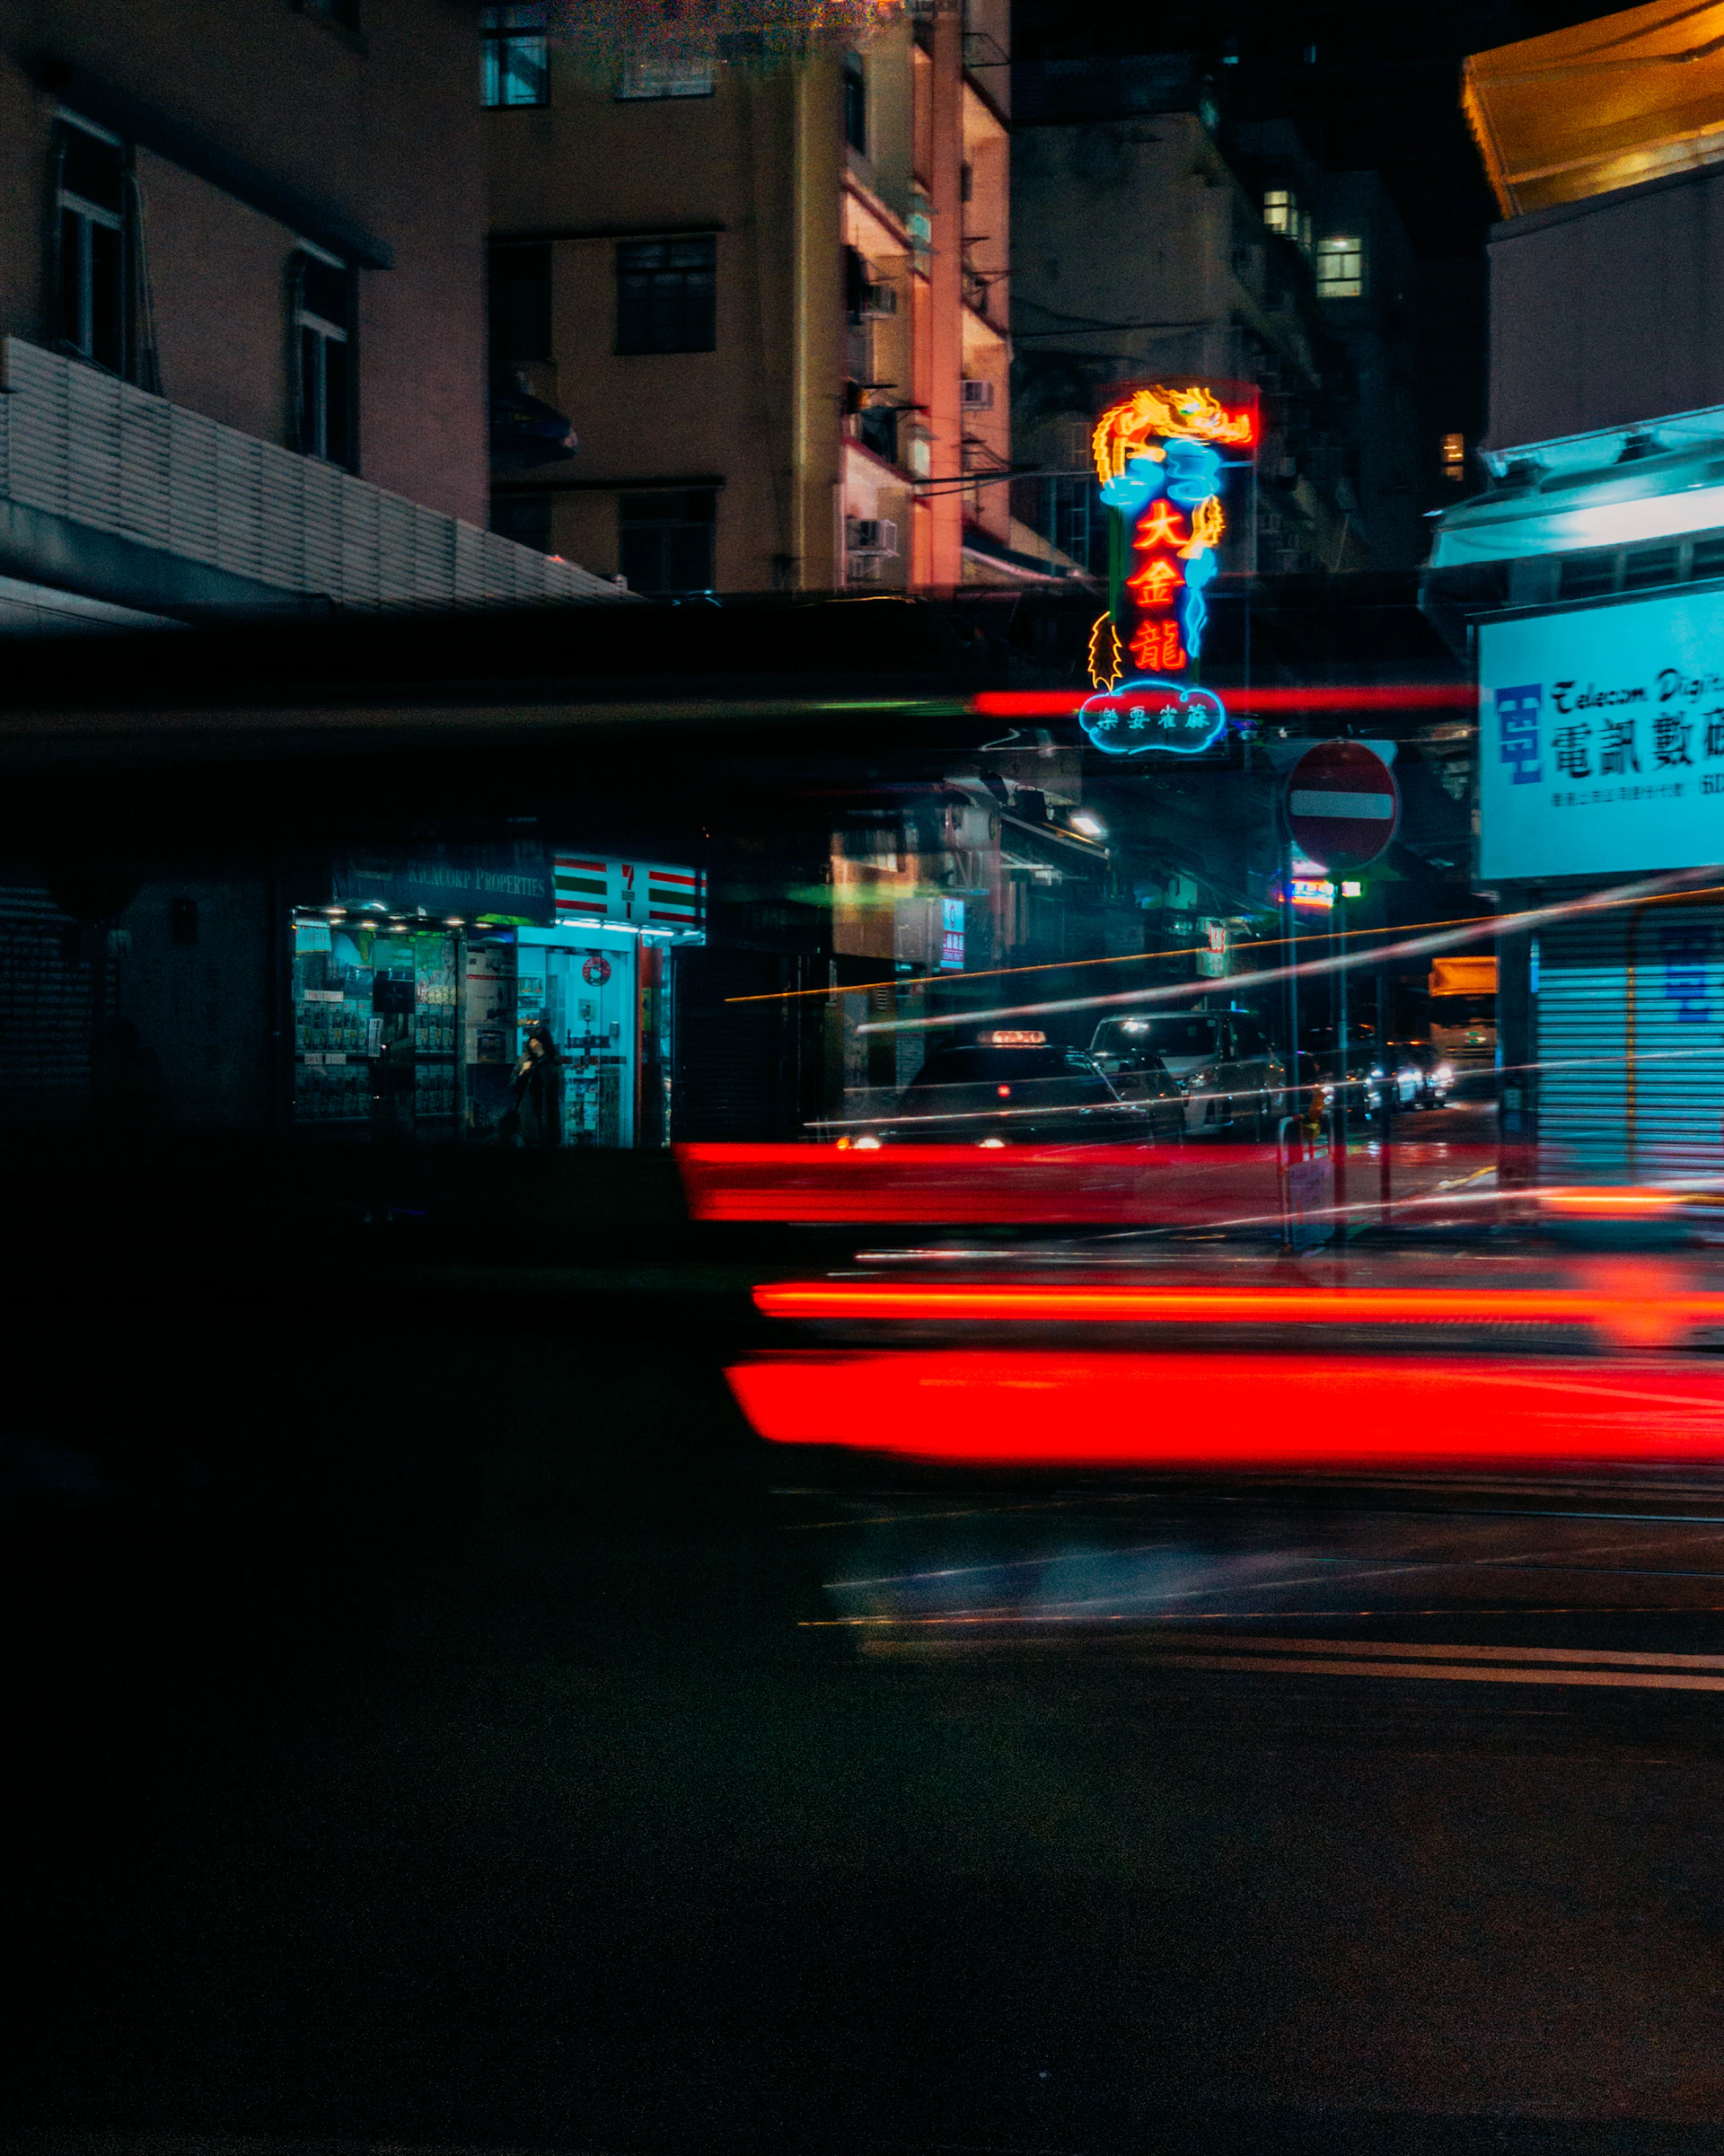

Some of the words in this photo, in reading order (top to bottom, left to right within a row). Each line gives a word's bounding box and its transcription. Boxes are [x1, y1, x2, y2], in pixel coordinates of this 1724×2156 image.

[1127, 499, 1189, 671] 大金龍
[1551, 680, 1649, 714] Telecom
[476, 867, 545, 898] PROPERTIES
[998, 1031, 1040, 1042] TAXI
